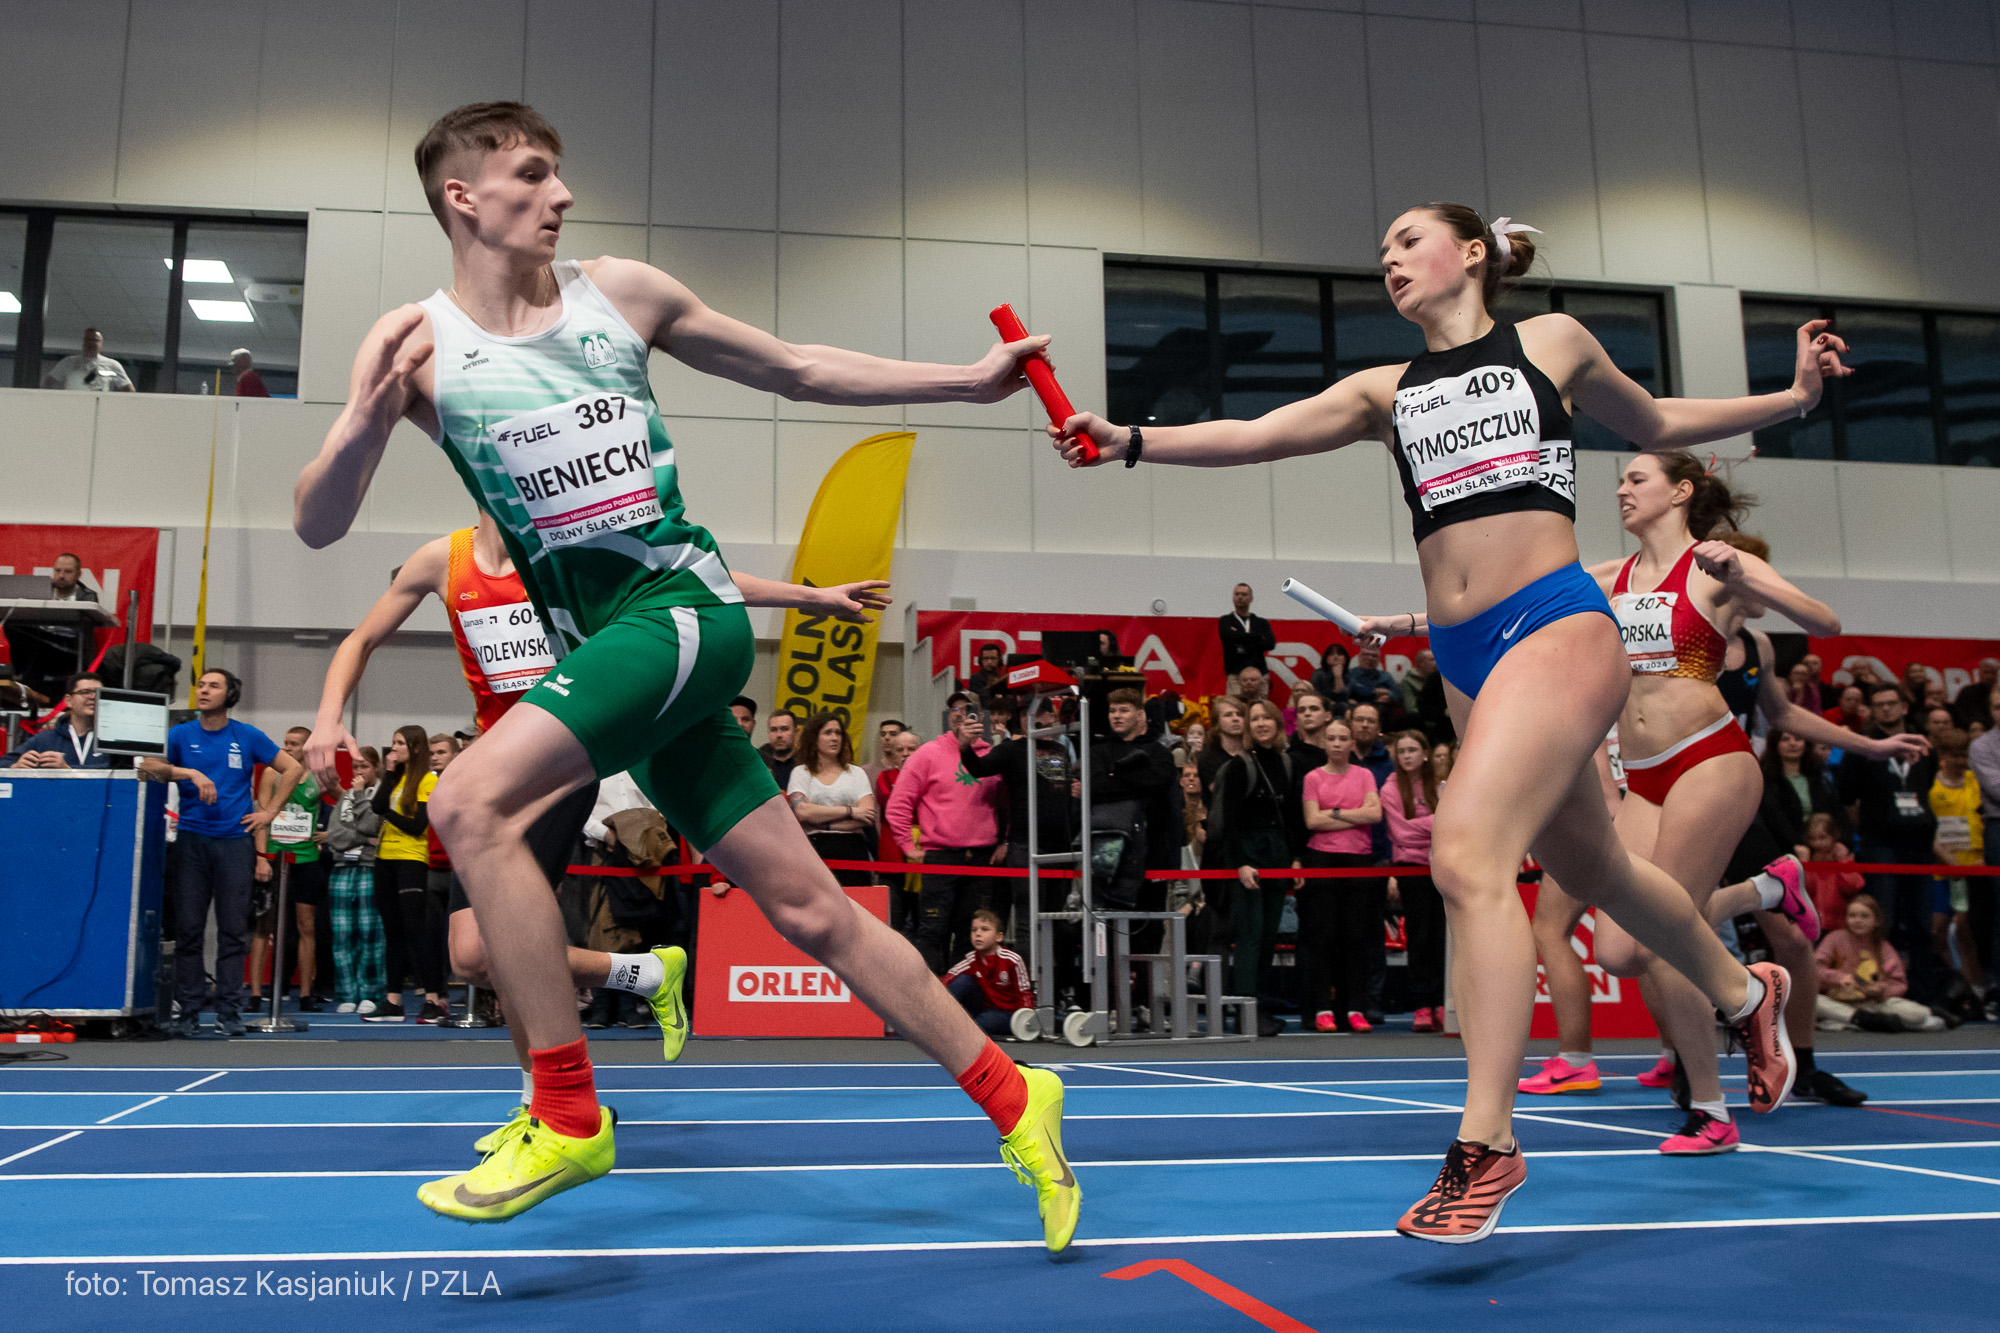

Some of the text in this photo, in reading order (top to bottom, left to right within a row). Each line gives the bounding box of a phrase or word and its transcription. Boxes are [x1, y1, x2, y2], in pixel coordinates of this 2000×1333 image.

[462, 357, 489, 370] erima
[1465, 371, 1515, 398] 409
[575, 396, 626, 429] 387
[1411, 395, 1450, 417] FUEL
[511, 423, 560, 447] FUEL
[1406, 409, 1535, 465] TYMOSZCZUK
[515, 440, 651, 502] BIENIECKI
[1426, 476, 1452, 488] Halowe
[1452, 463, 1490, 481] Mistrzostwa
[1490, 459, 1512, 467] Polski
[1430, 484, 1463, 501] OLNY
[1465, 472, 1502, 491] ŚLĄSK
[1504, 465, 1535, 479] 2024
[570, 504, 613, 521] Mistrzostwa
[613, 495, 635, 507] Polski
[549, 504, 656, 542] DOLNY ŚLĄSK 2024
[460, 591, 478, 600] esa
[1635, 597, 1667, 611] 607
[509, 608, 540, 625] 60
[1621, 623, 1667, 643] ORSKA
[1645, 661, 1667, 669] 2024
[502, 680, 527, 689] ŚLĄSK
[736, 971, 842, 996] ORLEN
[1770, 970, 1783, 1026] balance
